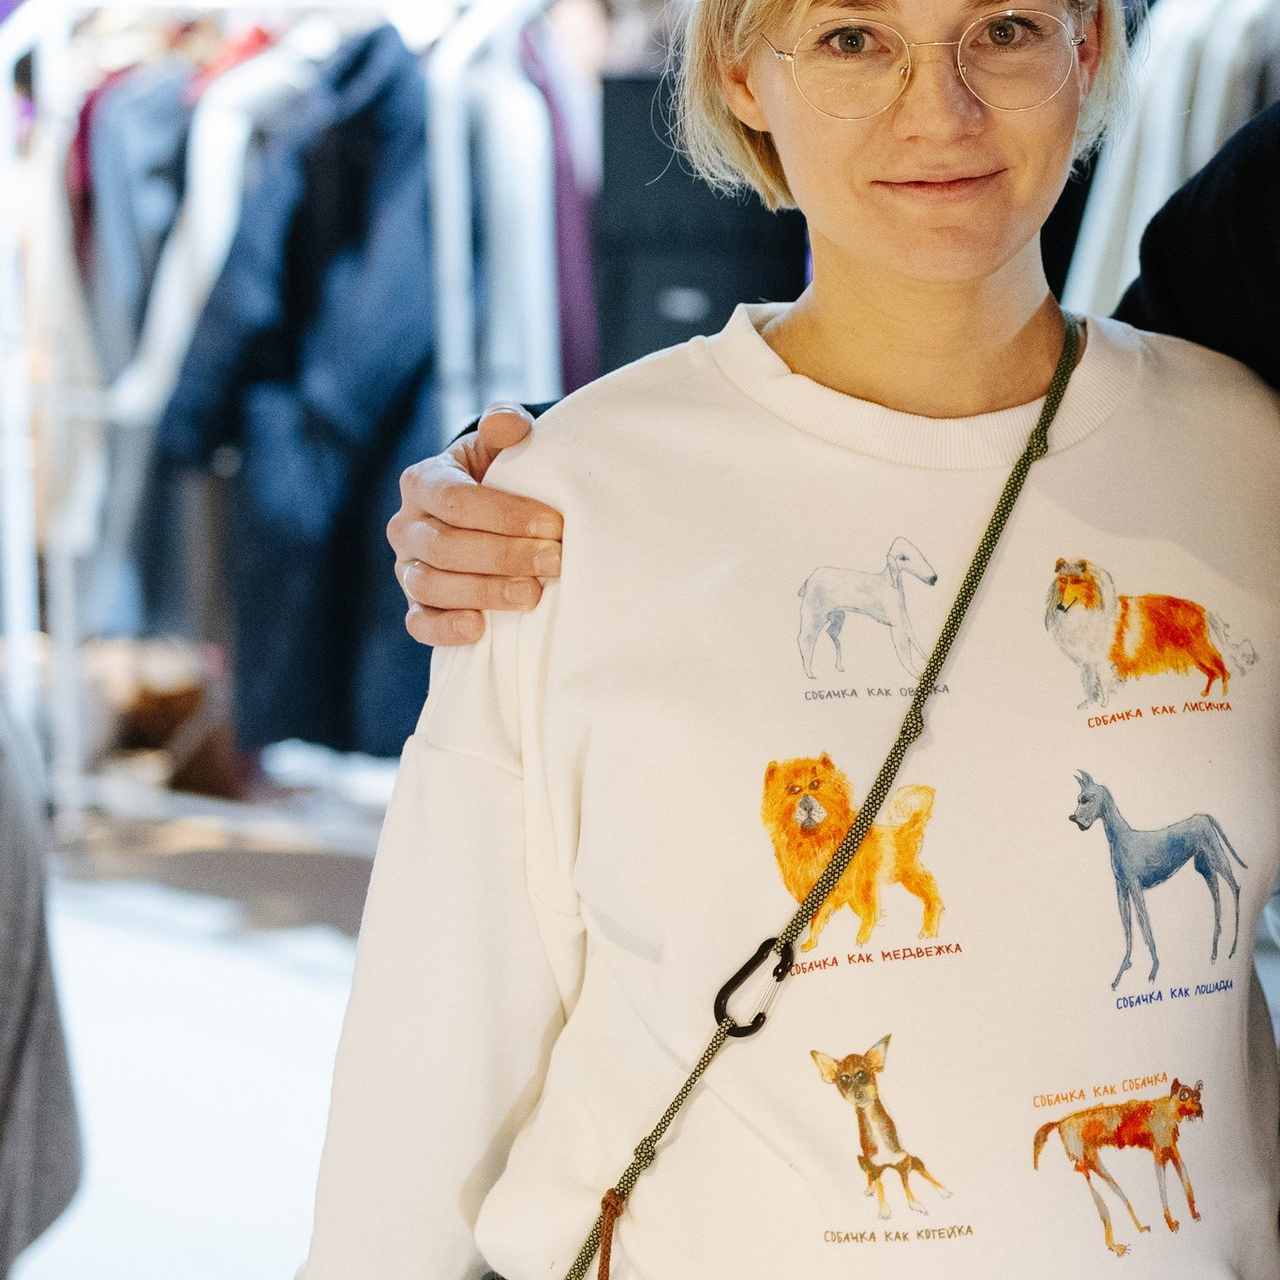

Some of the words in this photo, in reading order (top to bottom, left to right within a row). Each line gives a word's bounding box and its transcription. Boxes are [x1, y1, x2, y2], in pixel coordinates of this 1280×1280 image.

[804, 688, 858, 701] СОБАЧКА
[867, 687, 892, 697] КАК
[900, 684, 950, 697] ОВКА
[1087, 708, 1143, 728] СОБАЧКА
[1151, 705, 1176, 716] КАК
[1182, 701, 1232, 713] ЛИСИЧКА
[847, 953, 874, 964] КАК
[881, 942, 963, 962] МЕДВЕЖКА
[1116, 990, 1163, 1010] СОБАЧКА
[1170, 987, 1190, 999] КАК
[1033, 1089, 1086, 1108] СОБАЧКА
[1093, 1084, 1117, 1098] КАК
[1122, 1072, 1168, 1092] СОБАЧКА
[824, 1230, 877, 1243] СОБАЧКА
[884, 1230, 910, 1243] КАК
[916, 1225, 974, 1240] КОТЕЙКА
